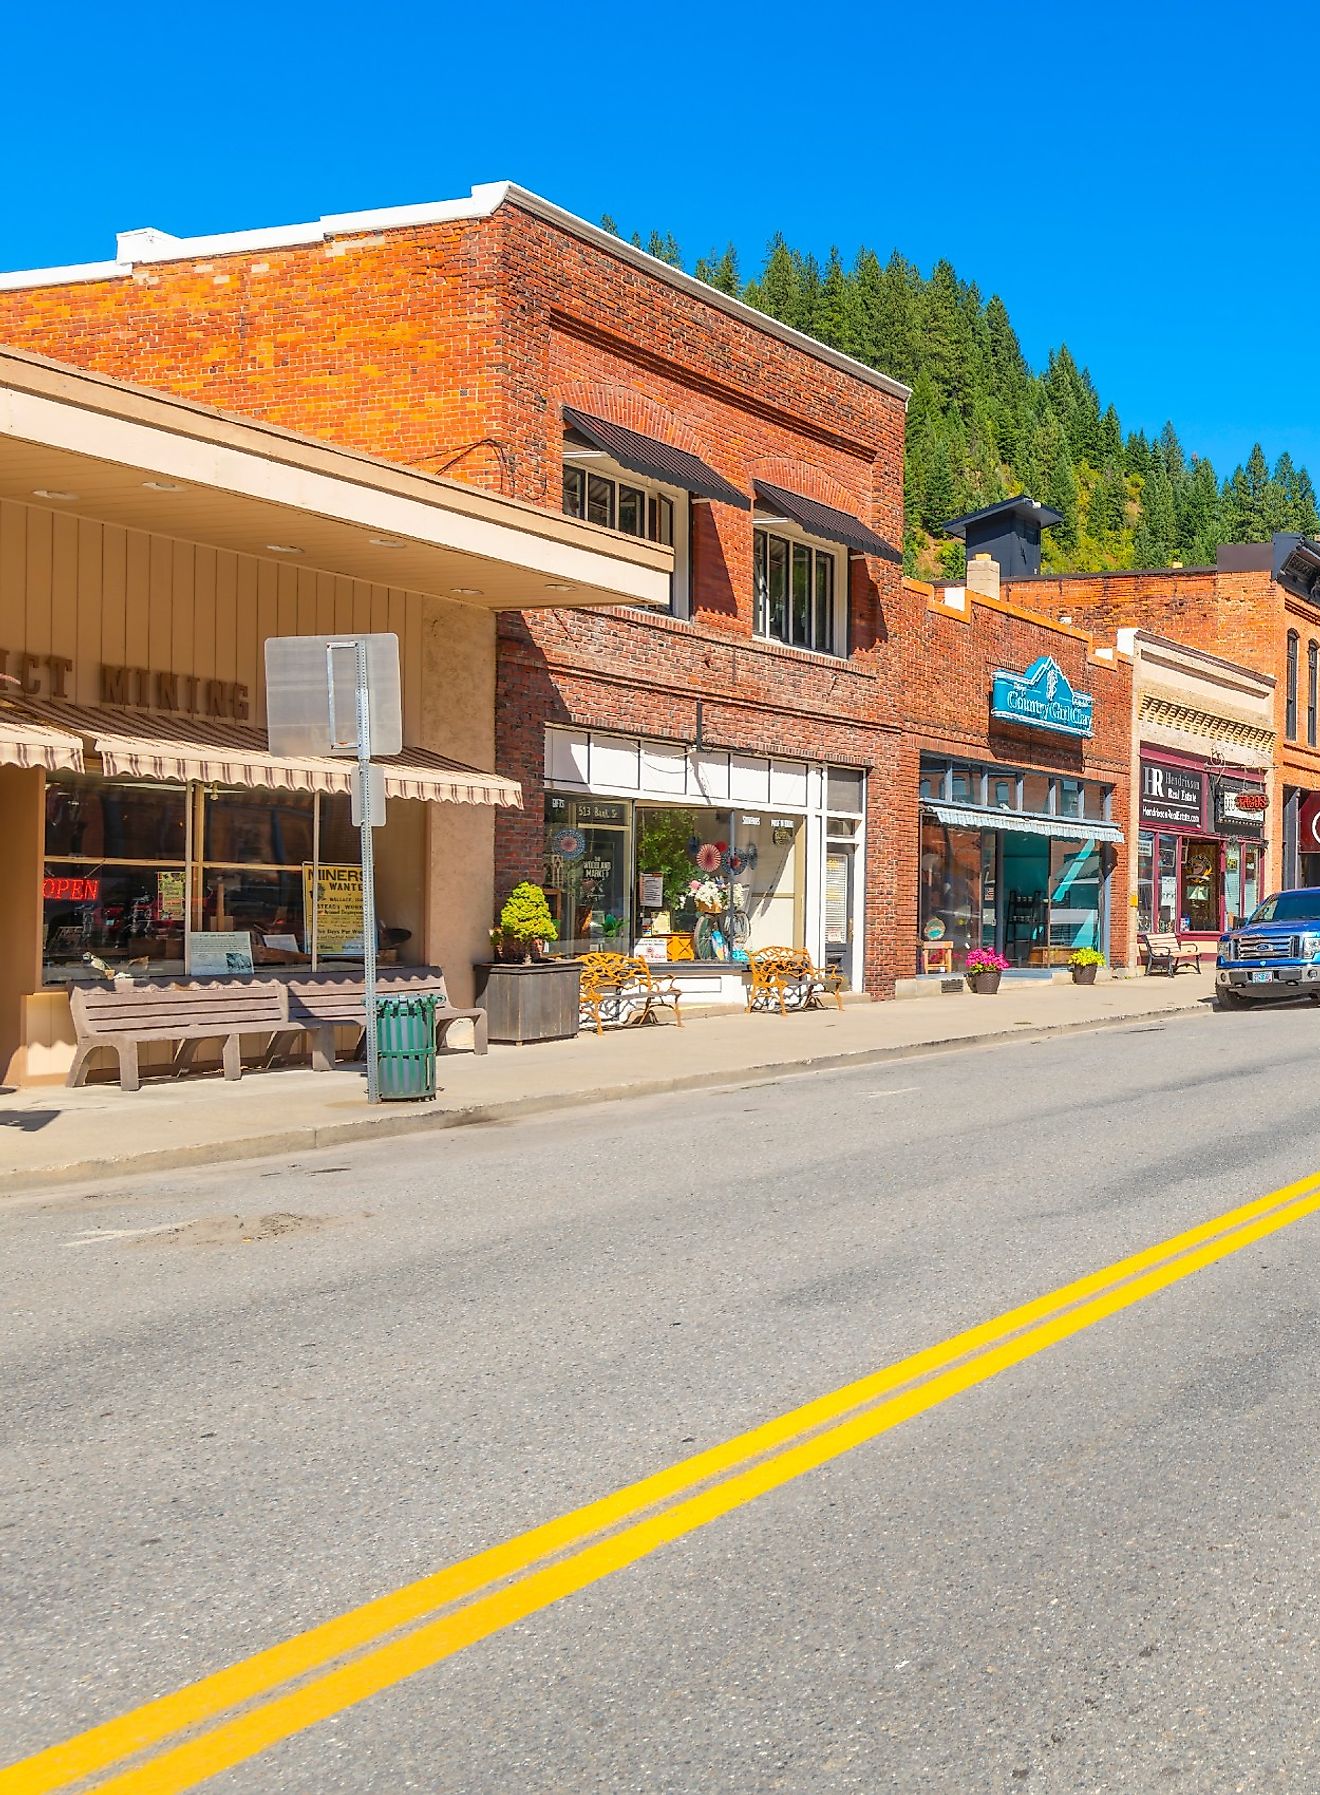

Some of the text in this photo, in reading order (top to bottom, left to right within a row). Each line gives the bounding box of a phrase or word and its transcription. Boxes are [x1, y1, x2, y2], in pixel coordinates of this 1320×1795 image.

[102, 664, 249, 720] MINING
[1007, 690, 1049, 720] Country
[1143, 766, 1165, 798] HR
[1167, 788, 1197, 803] Real Estate
[1235, 795, 1266, 811] TACOS
[578, 805, 591, 817] 513
[43, 878, 99, 900] OPEN
[329, 882, 363, 891] WANTE
